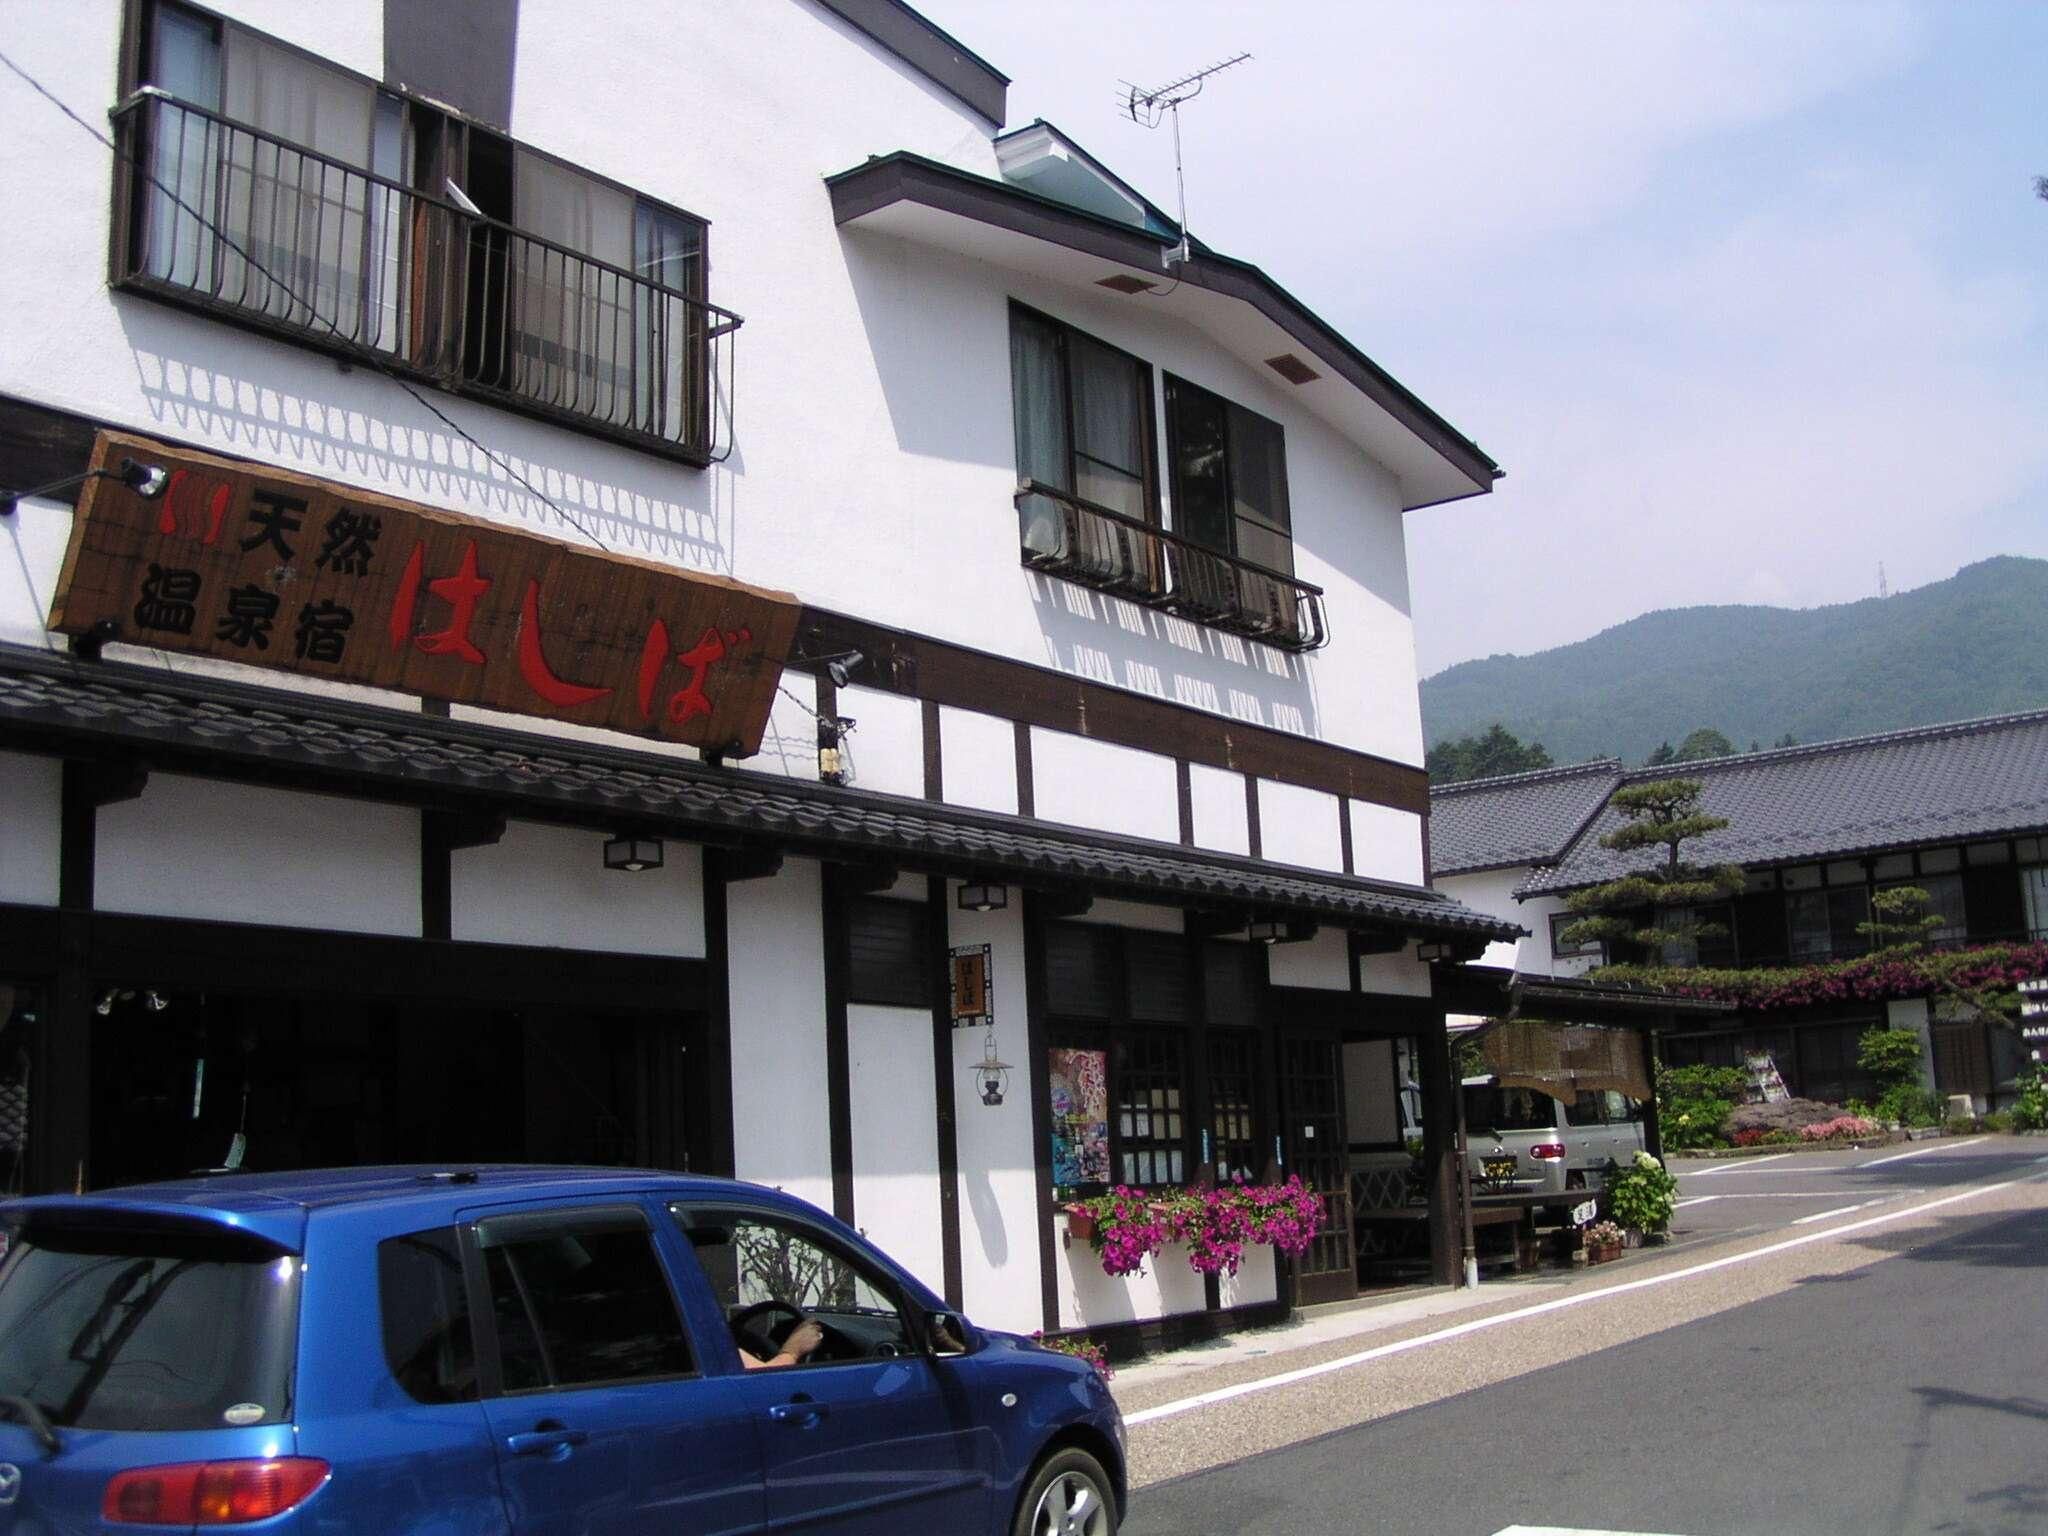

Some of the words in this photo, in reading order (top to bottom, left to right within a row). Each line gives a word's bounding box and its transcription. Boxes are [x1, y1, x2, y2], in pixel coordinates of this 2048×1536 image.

[240, 488, 381, 577] 天然
[134, 563, 354, 664] 温泉宿
[390, 540, 749, 724] はしば
